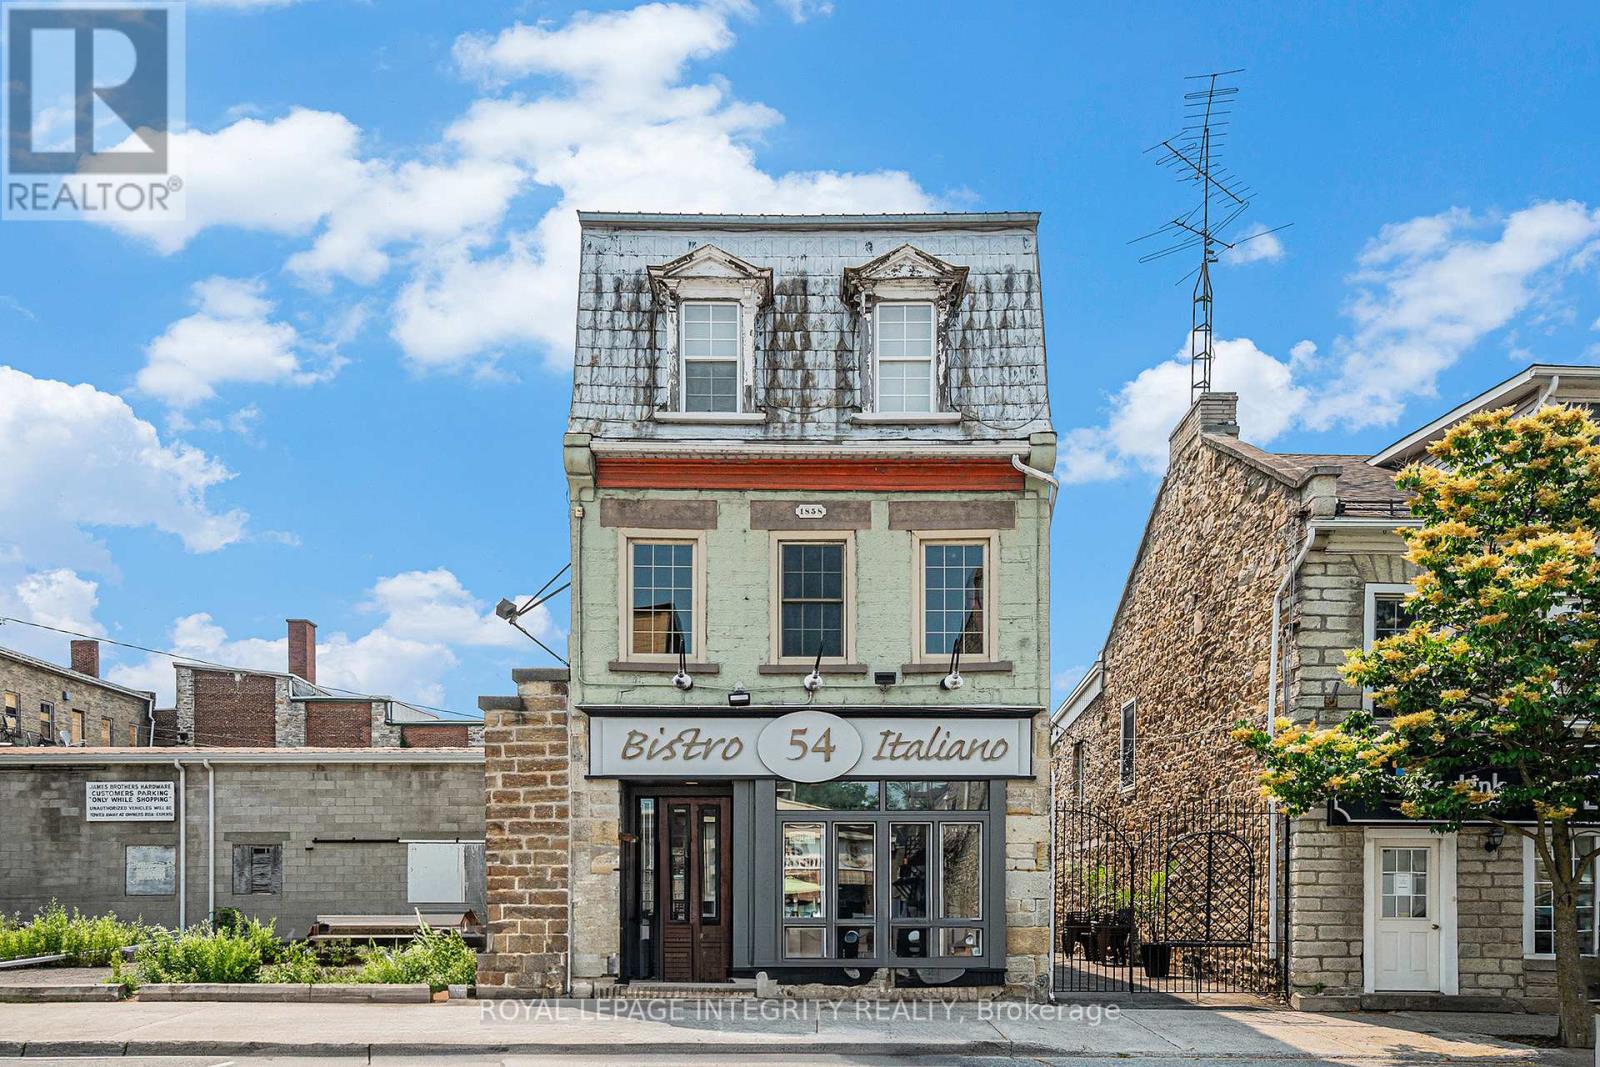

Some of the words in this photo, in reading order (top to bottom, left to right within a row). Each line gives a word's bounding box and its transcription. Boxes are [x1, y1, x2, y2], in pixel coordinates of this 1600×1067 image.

[620, 727, 744, 761] Bistro
[786, 727, 836, 762] 54
[872, 726, 1009, 761] Italiano
